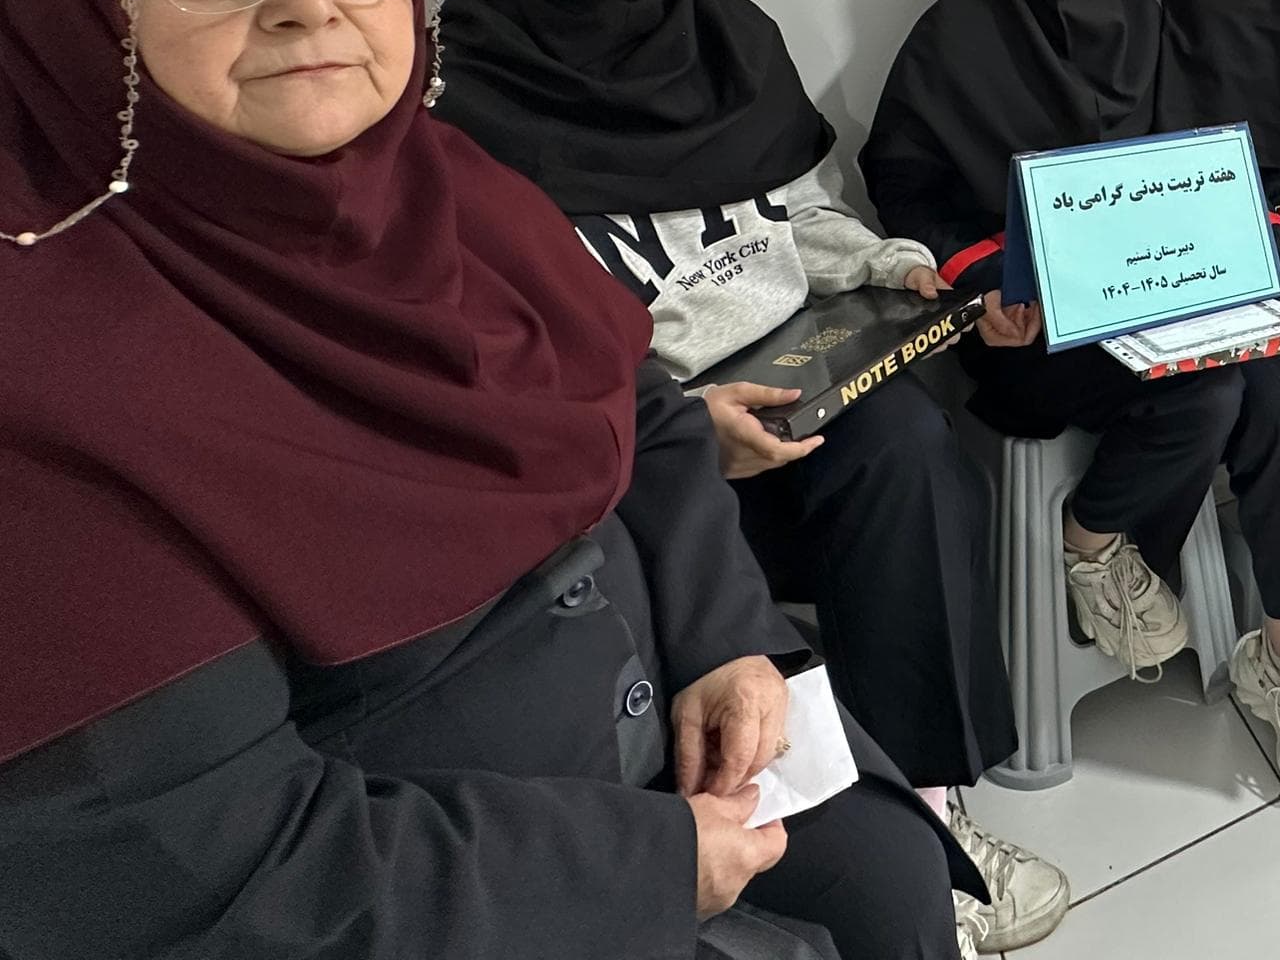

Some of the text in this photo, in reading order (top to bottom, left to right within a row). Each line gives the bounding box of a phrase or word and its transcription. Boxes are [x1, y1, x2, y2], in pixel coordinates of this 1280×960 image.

[1053, 166, 1237, 212] هفته تربیت بدنی گرامی باد
[675, 236, 770, 292] New York City
[1126, 240, 1195, 267] دبیرستان تسنیم
[711, 264, 745, 287] 1993
[1171, 269, 1207, 289] تحصیلی
[1209, 265, 1227, 279] سال
[840, 313, 956, 406] NOTE BOOK
